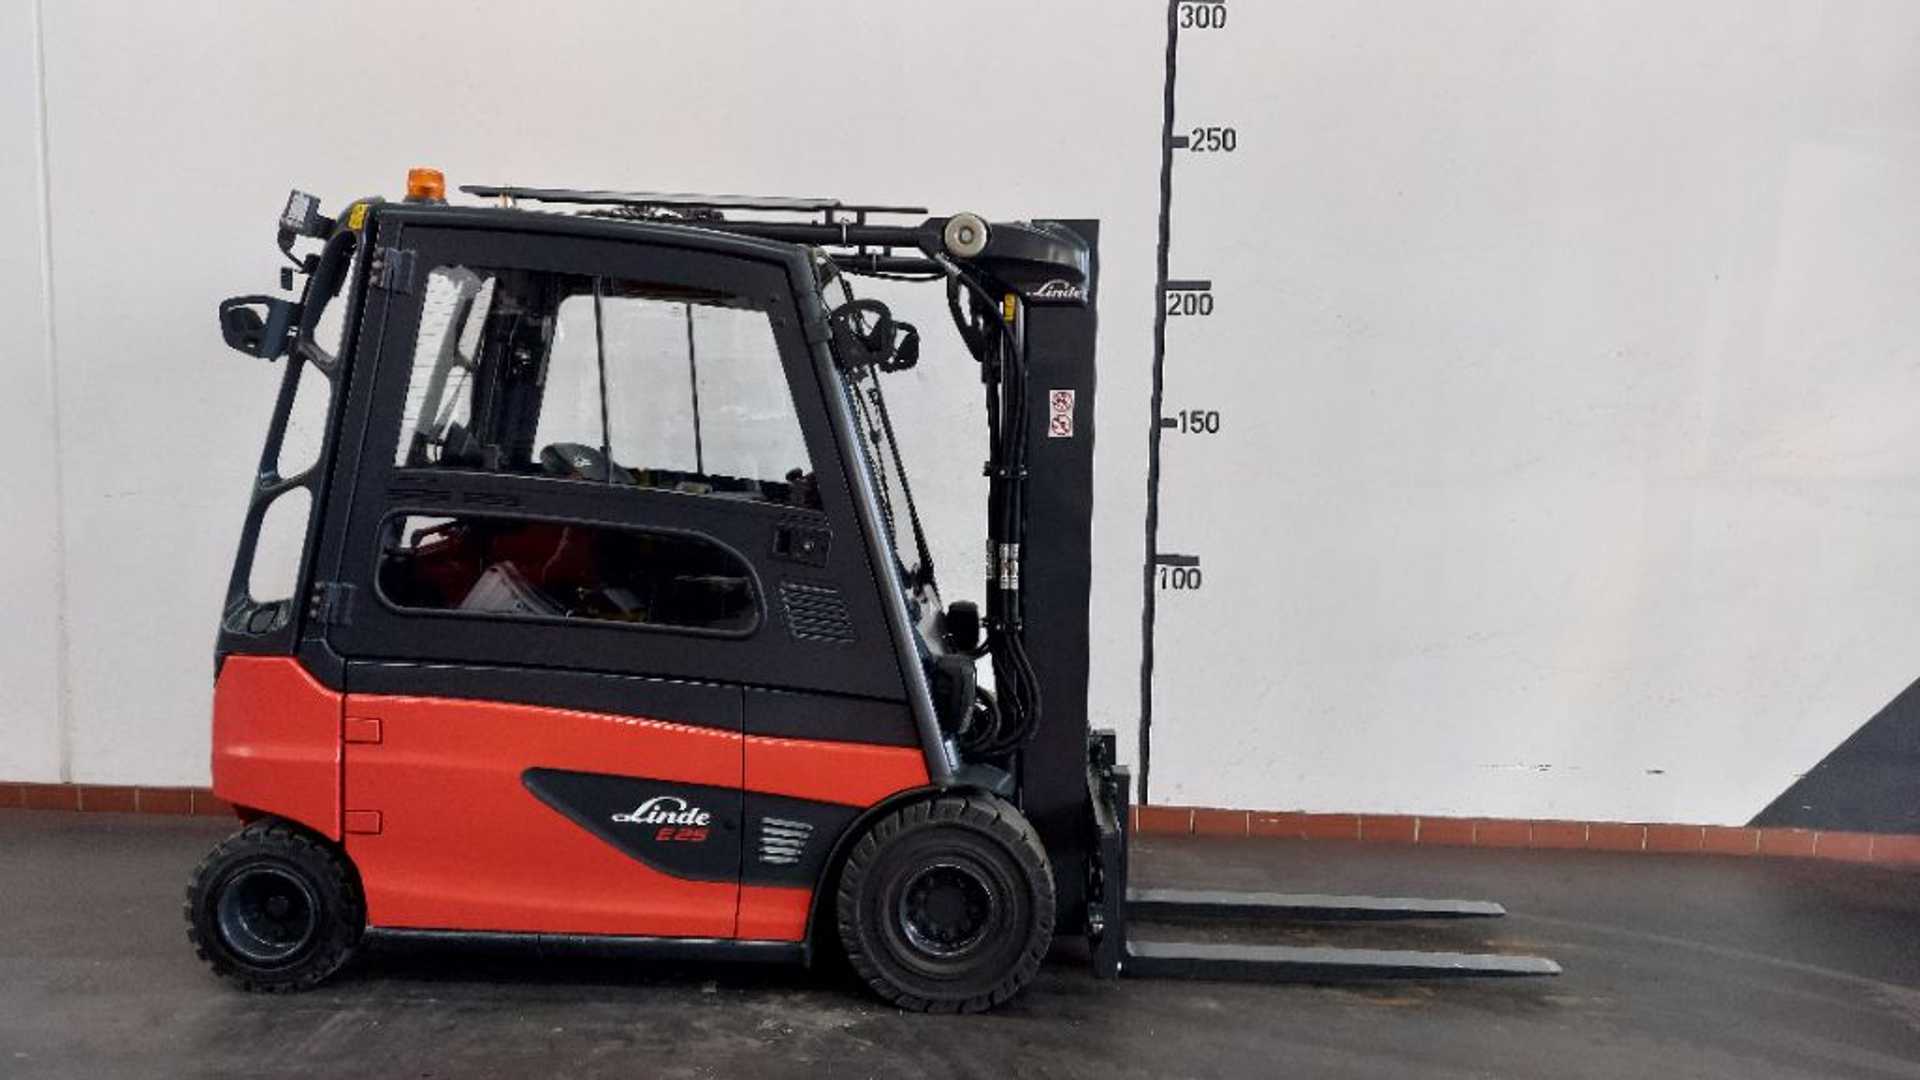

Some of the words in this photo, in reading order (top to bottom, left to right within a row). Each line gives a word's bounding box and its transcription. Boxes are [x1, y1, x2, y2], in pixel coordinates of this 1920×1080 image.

[1180, 4, 1227, 29] 300
[1190, 127, 1237, 152] 250
[1026, 278, 1083, 299] Linde
[1167, 293, 1214, 316] 200
[1178, 410, 1220, 434] 150
[1160, 567, 1202, 590] 100
[611, 795, 711, 826] Linde
[673, 827, 711, 842] 25
